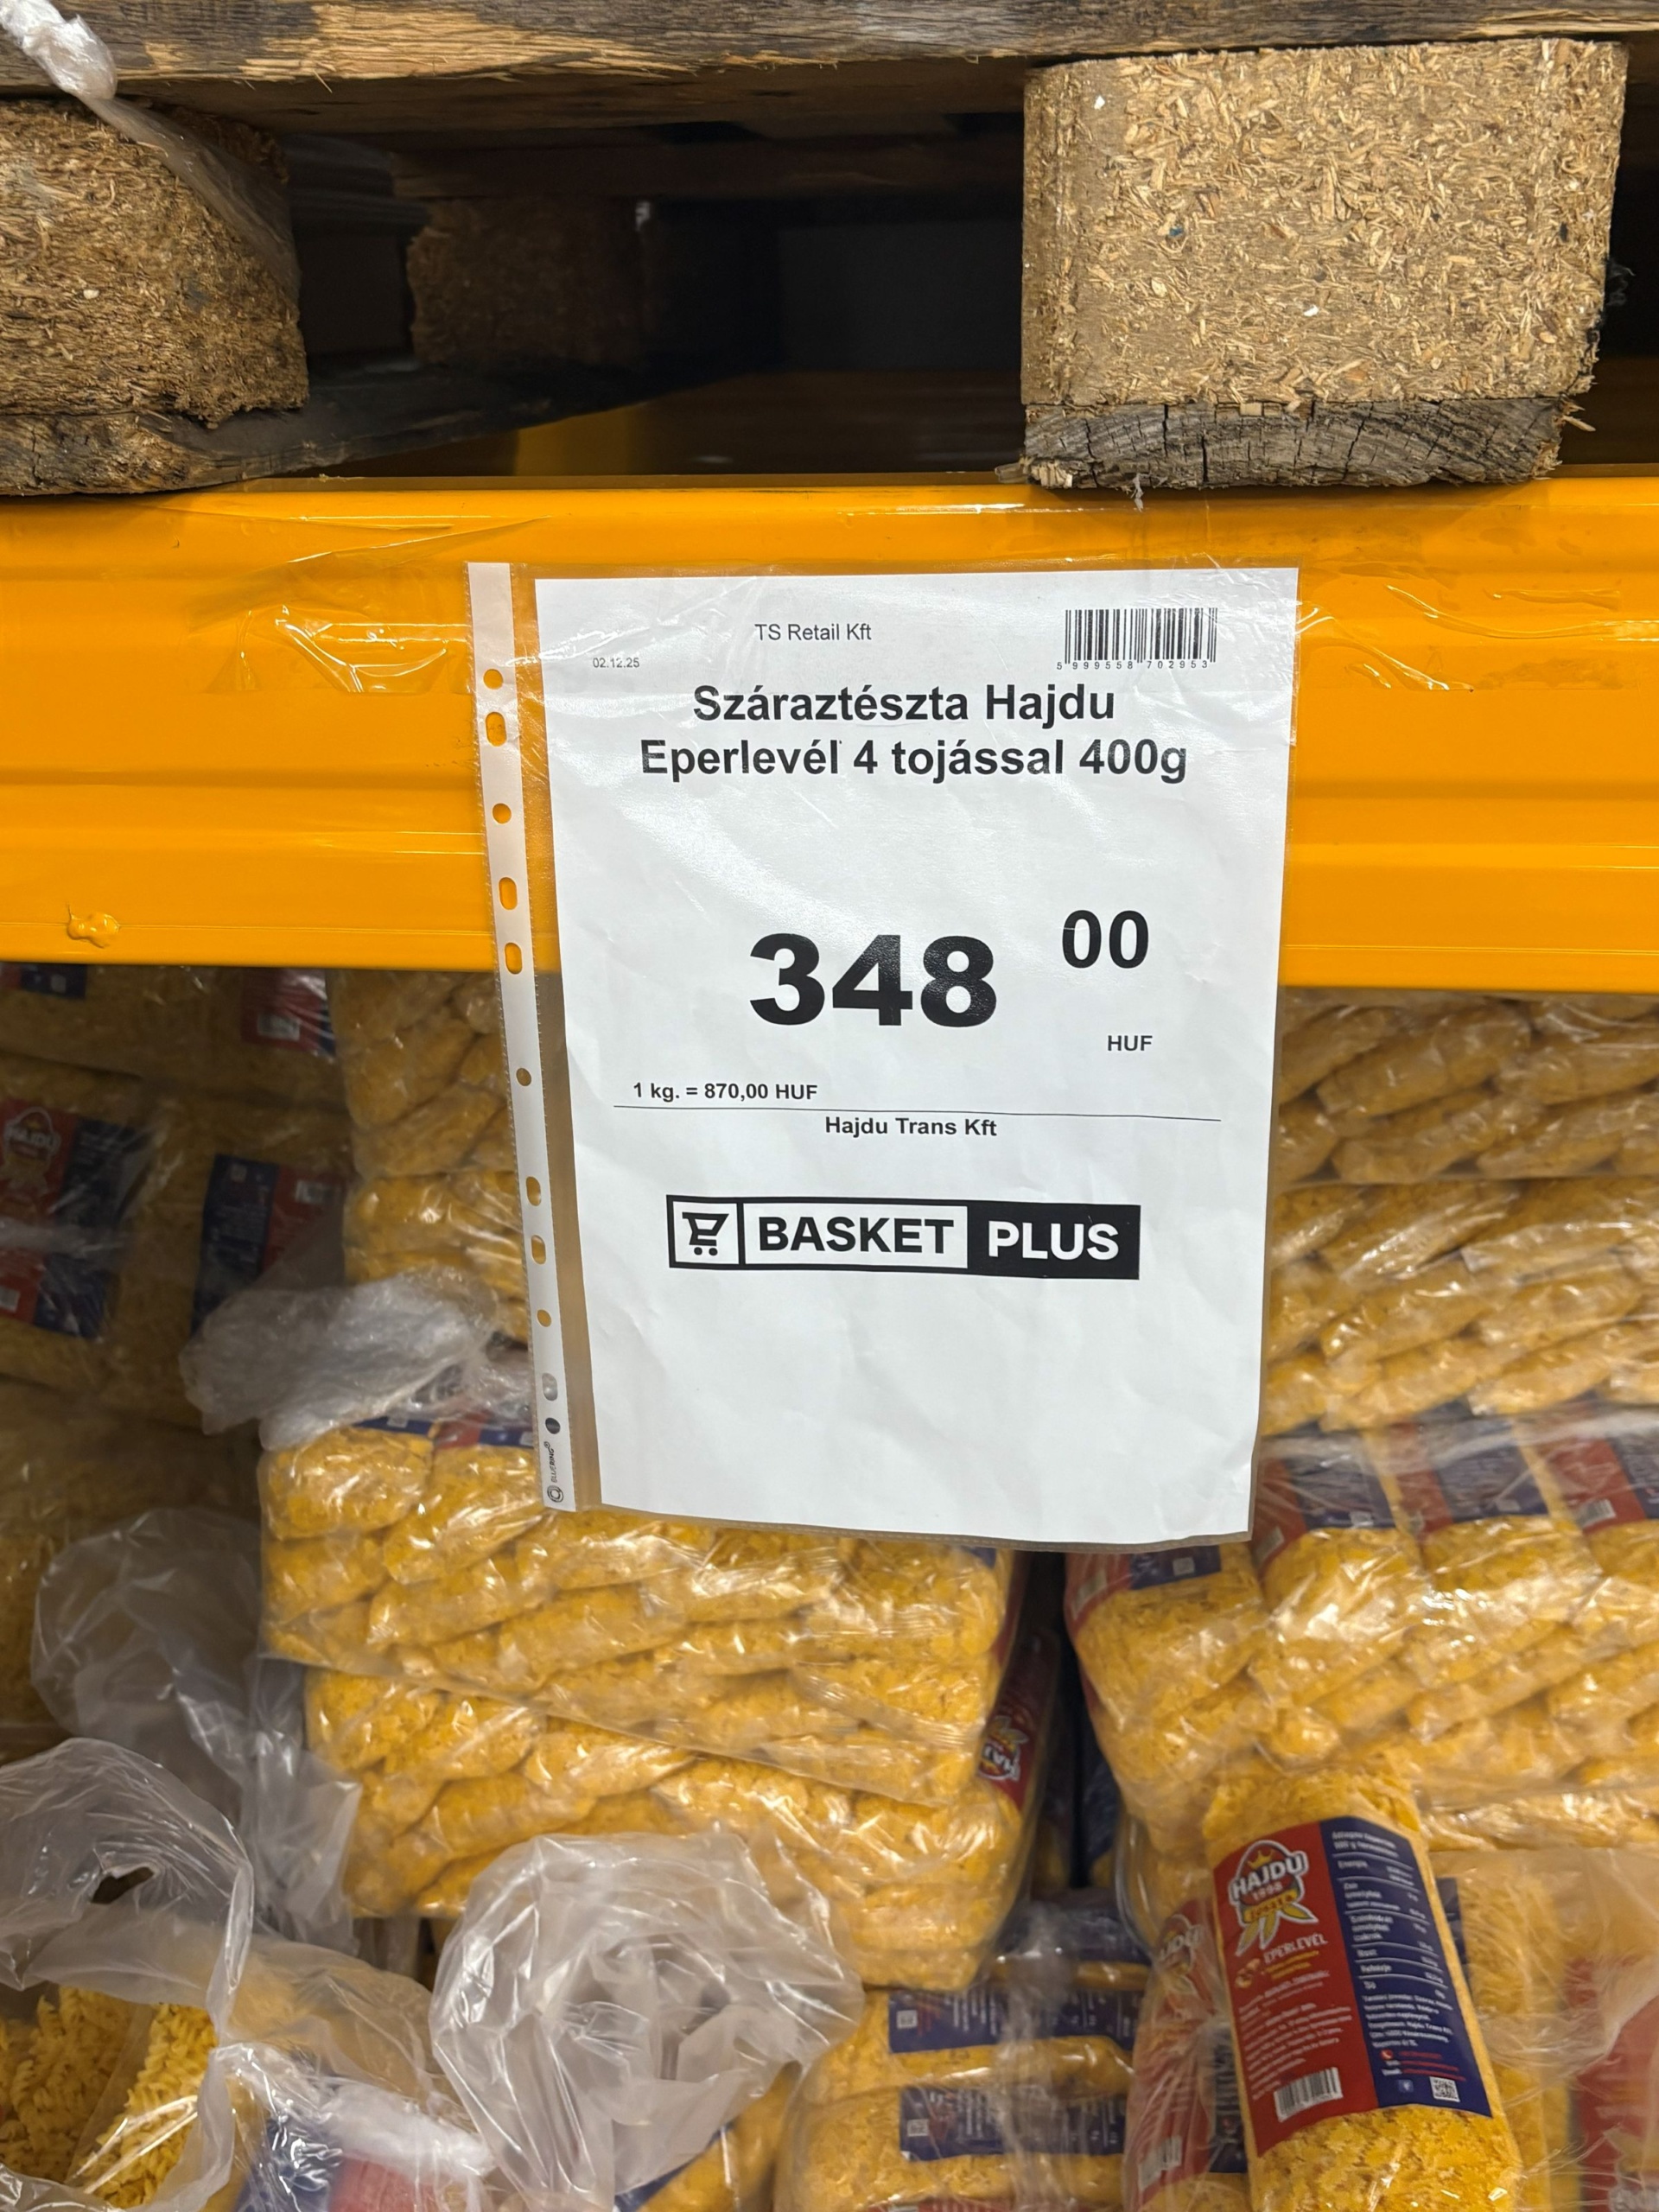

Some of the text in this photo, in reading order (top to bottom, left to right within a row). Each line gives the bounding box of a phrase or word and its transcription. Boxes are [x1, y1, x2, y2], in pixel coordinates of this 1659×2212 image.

[753, 622, 872, 641] TS Retail Kft
[593, 657, 640, 669] 02.12.25
[693, 683, 1115, 730] Száraztészta Hajdu
[641, 738, 1188, 785] Eperlevél 4 tojással 400g
[1062, 910, 1150, 969] 00
[749, 932, 998, 1028] 348
[1107, 1034, 1154, 1052] HUF
[633, 1082, 818, 1103] 1 kg. = 870,00 HUF
[825, 1116, 998, 1139] Hajdu Trans Kft
[758, 1216, 955, 1255] BASKET
[988, 1220, 1120, 1261] PLUS
[1233, 1855, 1304, 1900] HAJDU
